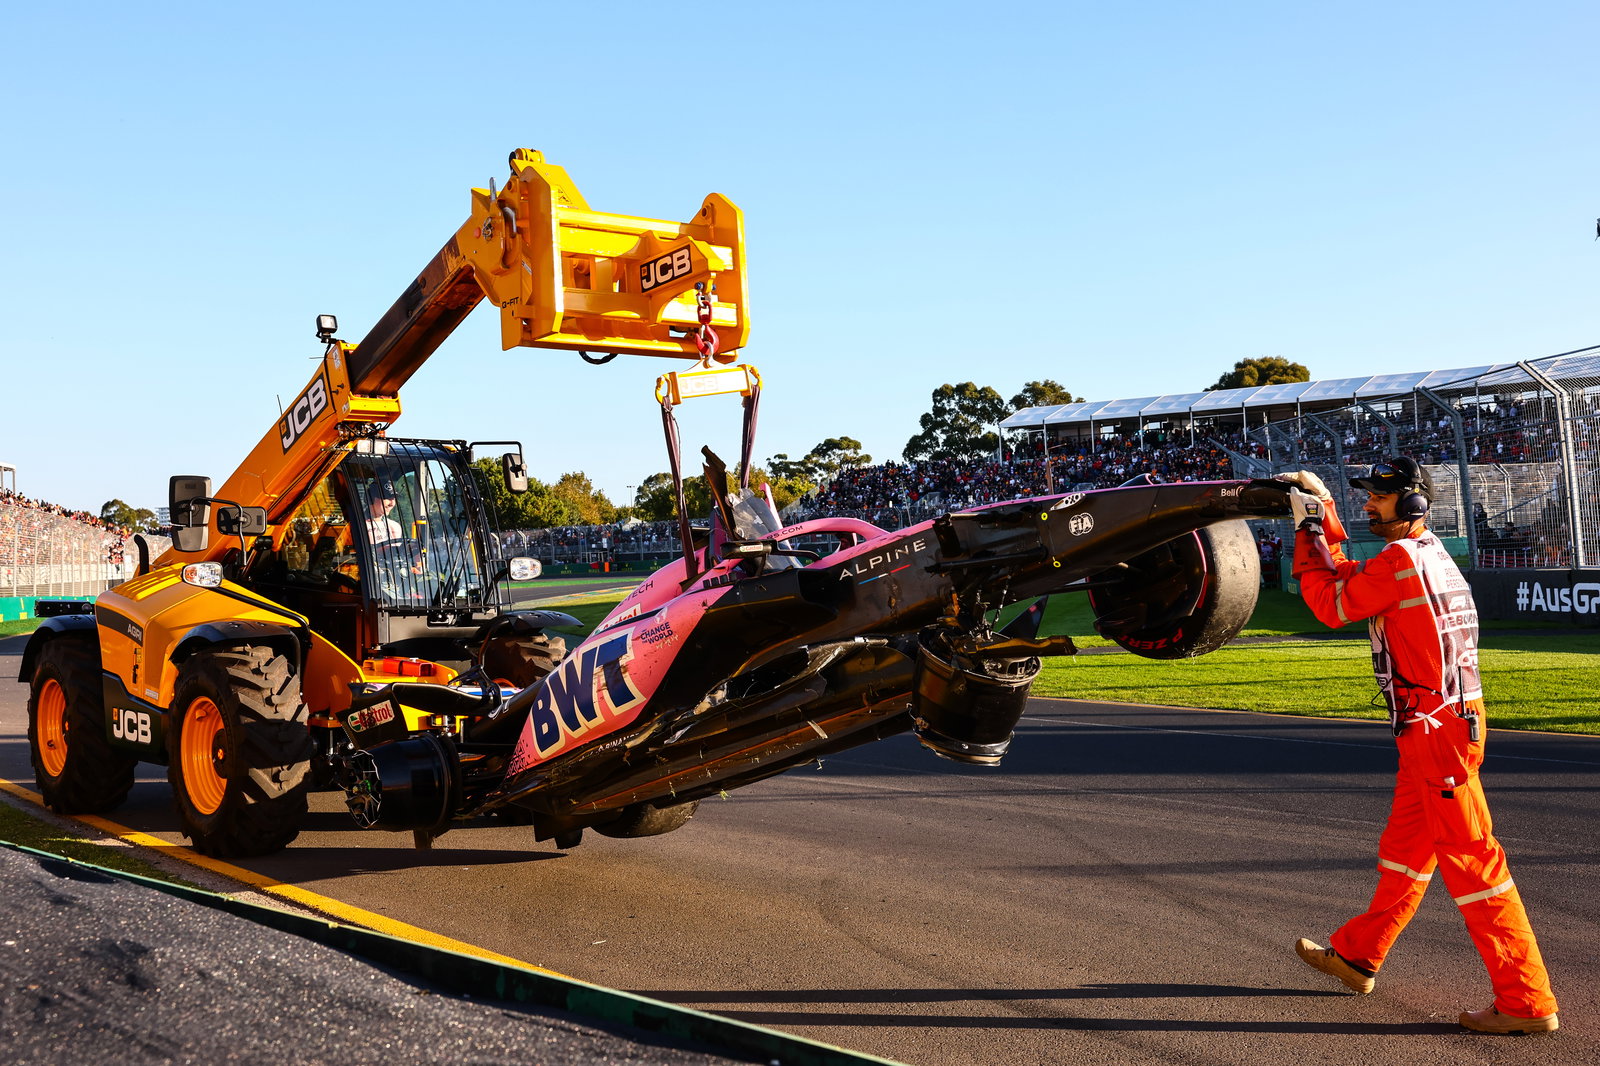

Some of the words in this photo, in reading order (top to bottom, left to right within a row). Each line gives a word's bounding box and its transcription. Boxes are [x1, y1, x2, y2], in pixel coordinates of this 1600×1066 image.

[642, 248, 691, 290] JCB
[681, 376, 717, 392] JCB
[282, 378, 327, 449] JCB
[1221, 488, 1236, 497] Bell
[839, 538, 927, 581] ALPINE
[127, 623, 142, 641] AGRI
[640, 621, 671, 640] CHANGE
[648, 629, 674, 644] WORLD
[1172, 627, 1183, 643] P
[530, 631, 639, 755] BWT
[112, 707, 152, 744] JCB
